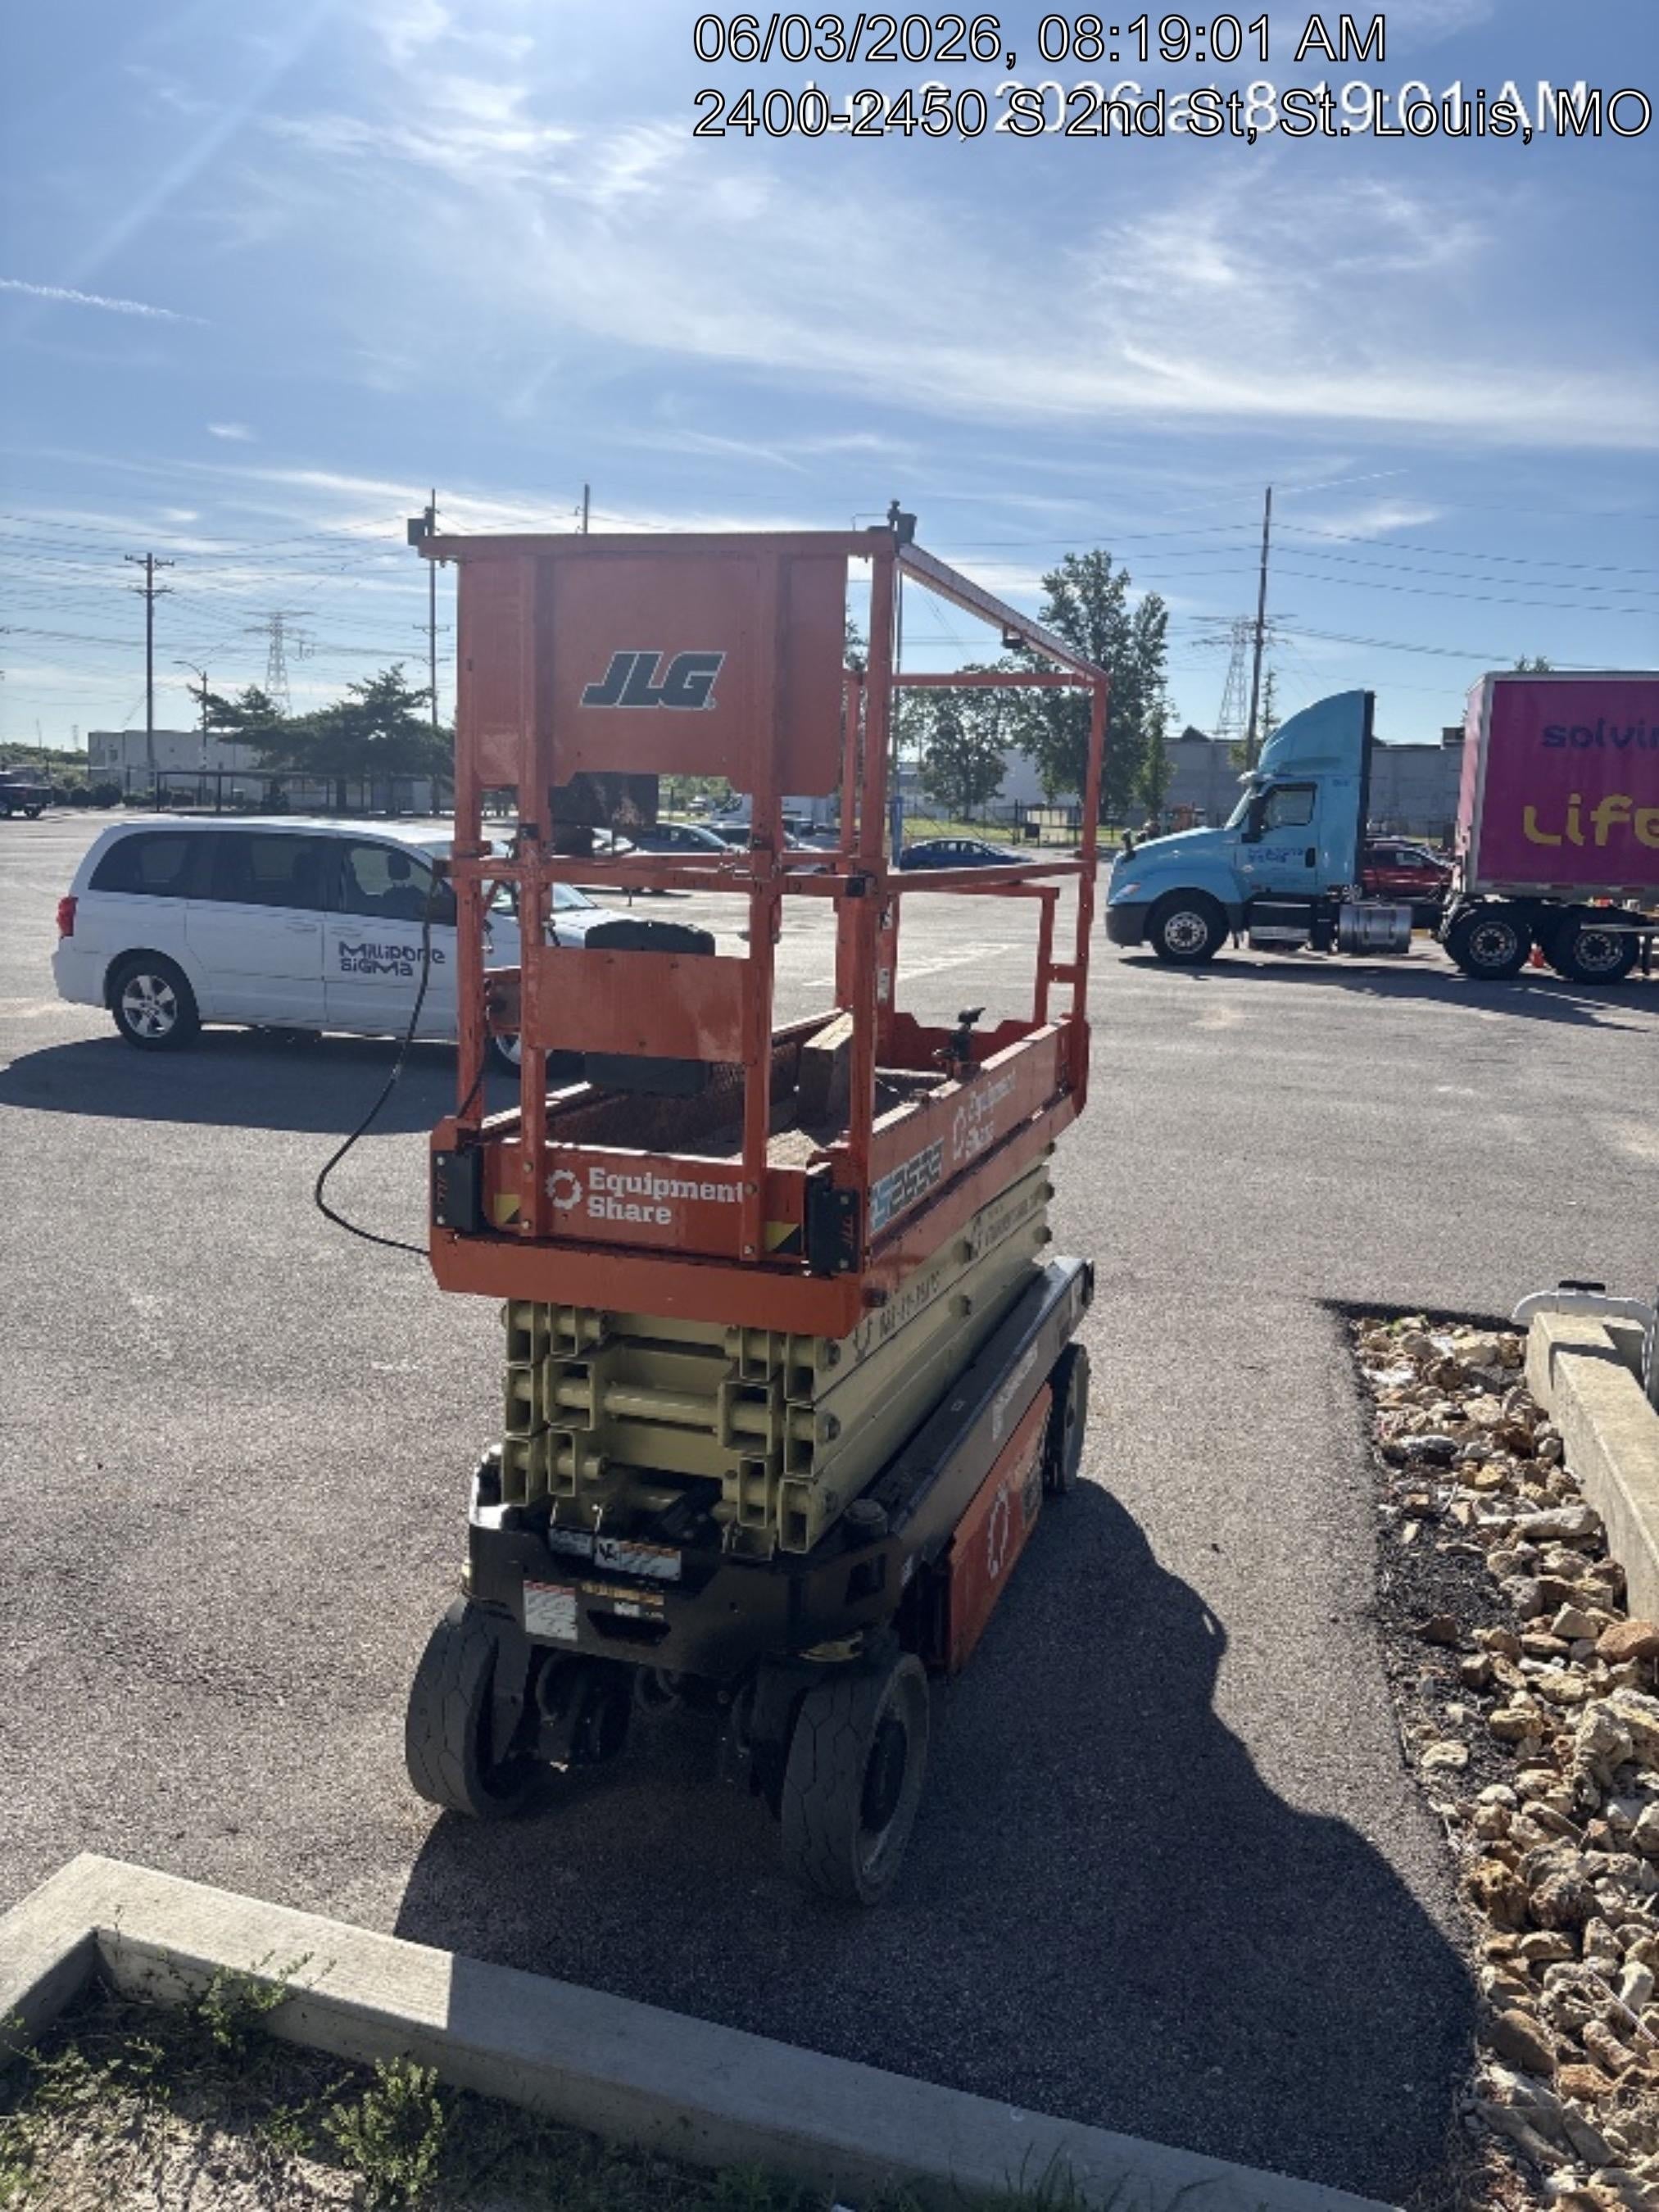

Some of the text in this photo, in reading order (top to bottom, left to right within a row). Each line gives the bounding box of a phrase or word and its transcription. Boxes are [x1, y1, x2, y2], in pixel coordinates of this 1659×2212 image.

[579, 650, 727, 710] JLG
[589, 1167, 743, 1203] Equipment
[587, 1196, 672, 1224] Share
